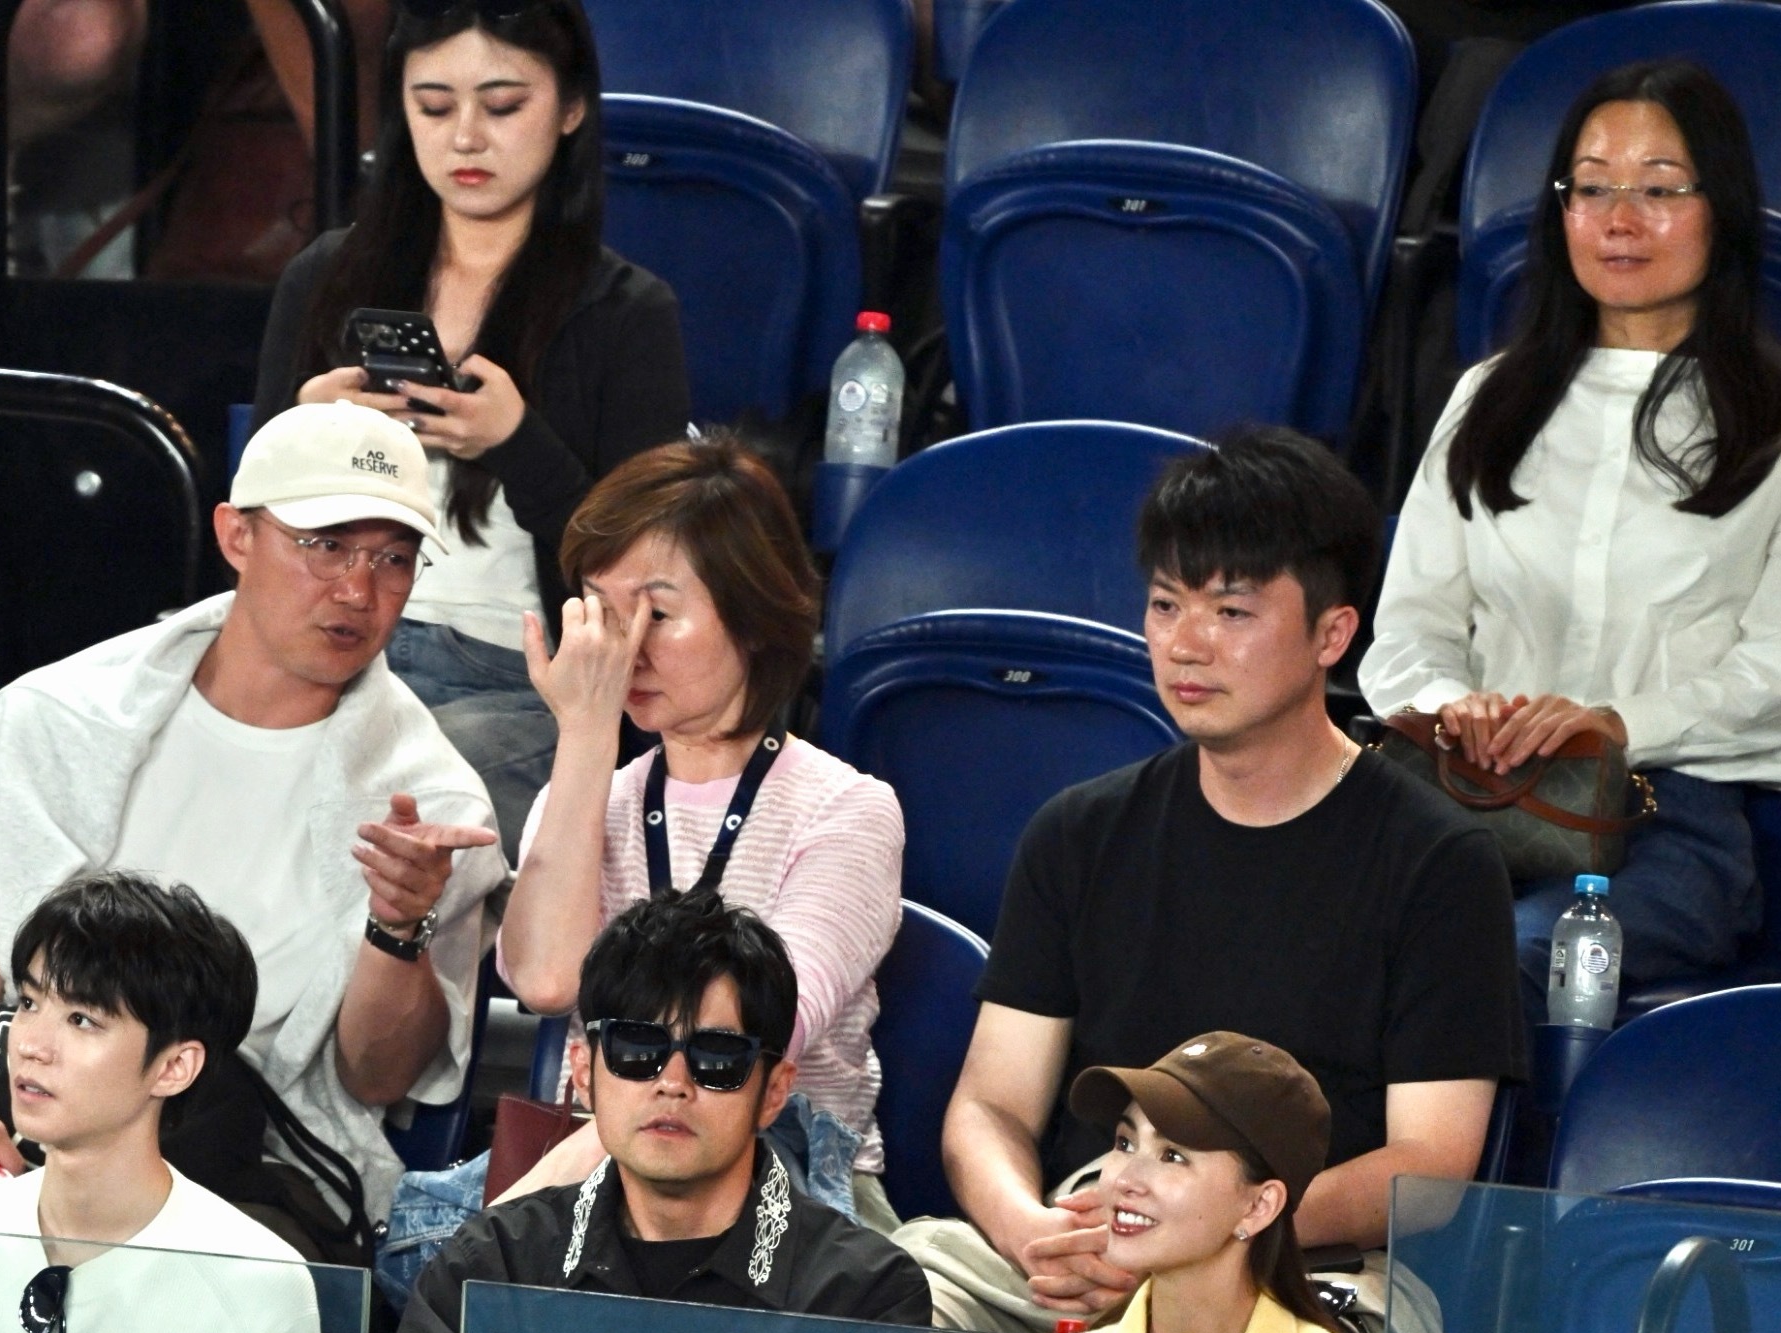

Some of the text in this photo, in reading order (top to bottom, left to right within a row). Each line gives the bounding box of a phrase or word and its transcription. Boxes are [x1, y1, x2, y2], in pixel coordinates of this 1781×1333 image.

[366, 450, 385, 461] AO
[352, 456, 399, 479] RESERVE
[1004, 670, 1031, 682] 300
[1729, 1238, 1755, 1252] 301
